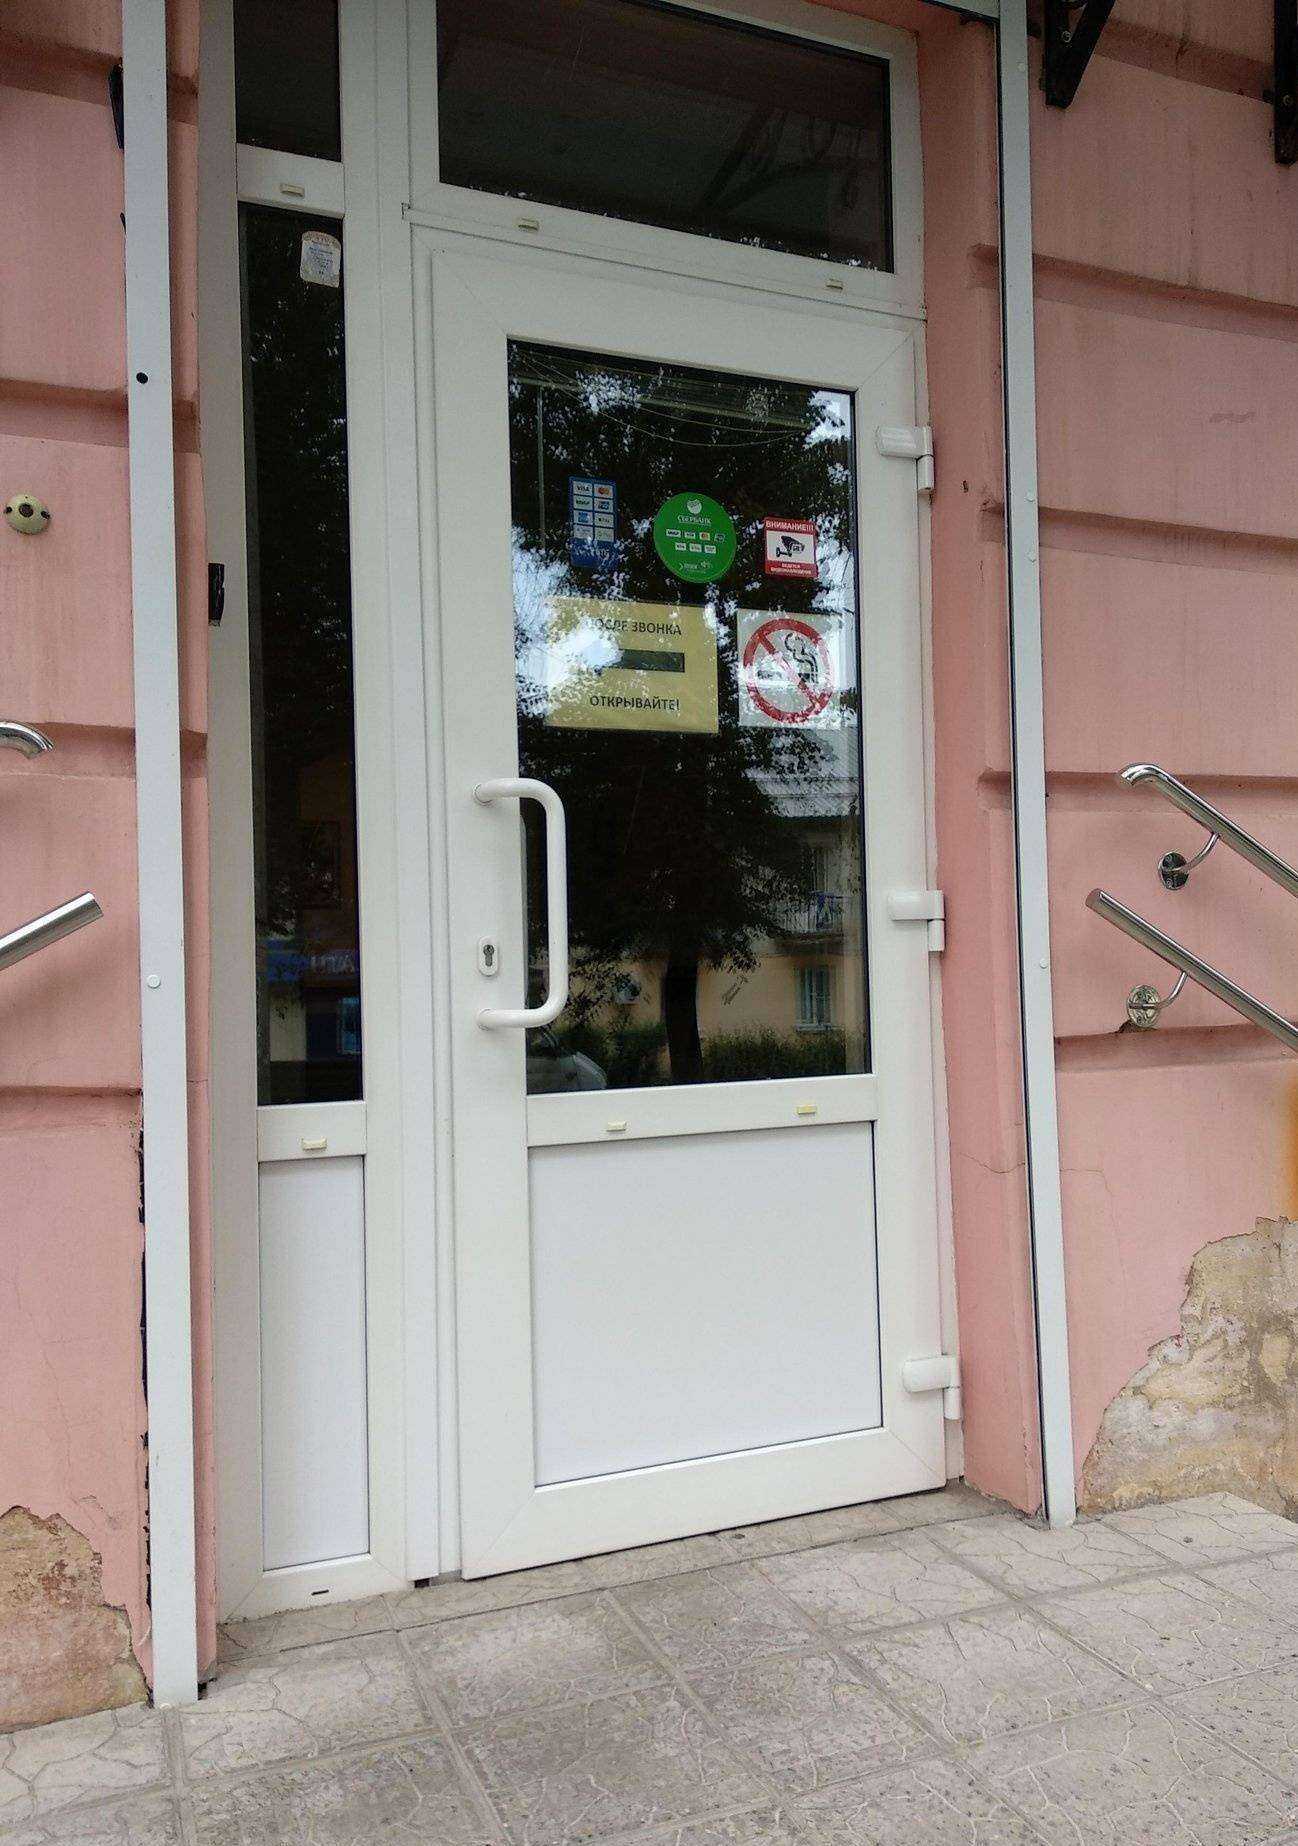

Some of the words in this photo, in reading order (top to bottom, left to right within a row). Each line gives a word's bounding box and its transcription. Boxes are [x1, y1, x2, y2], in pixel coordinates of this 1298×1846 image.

[765, 520, 815, 532] ВНИМАНИЕ!!!
[632, 621, 682, 636] ЗВОНКА
[589, 695, 680, 711] ОТКРЫВАЙТЕ!
